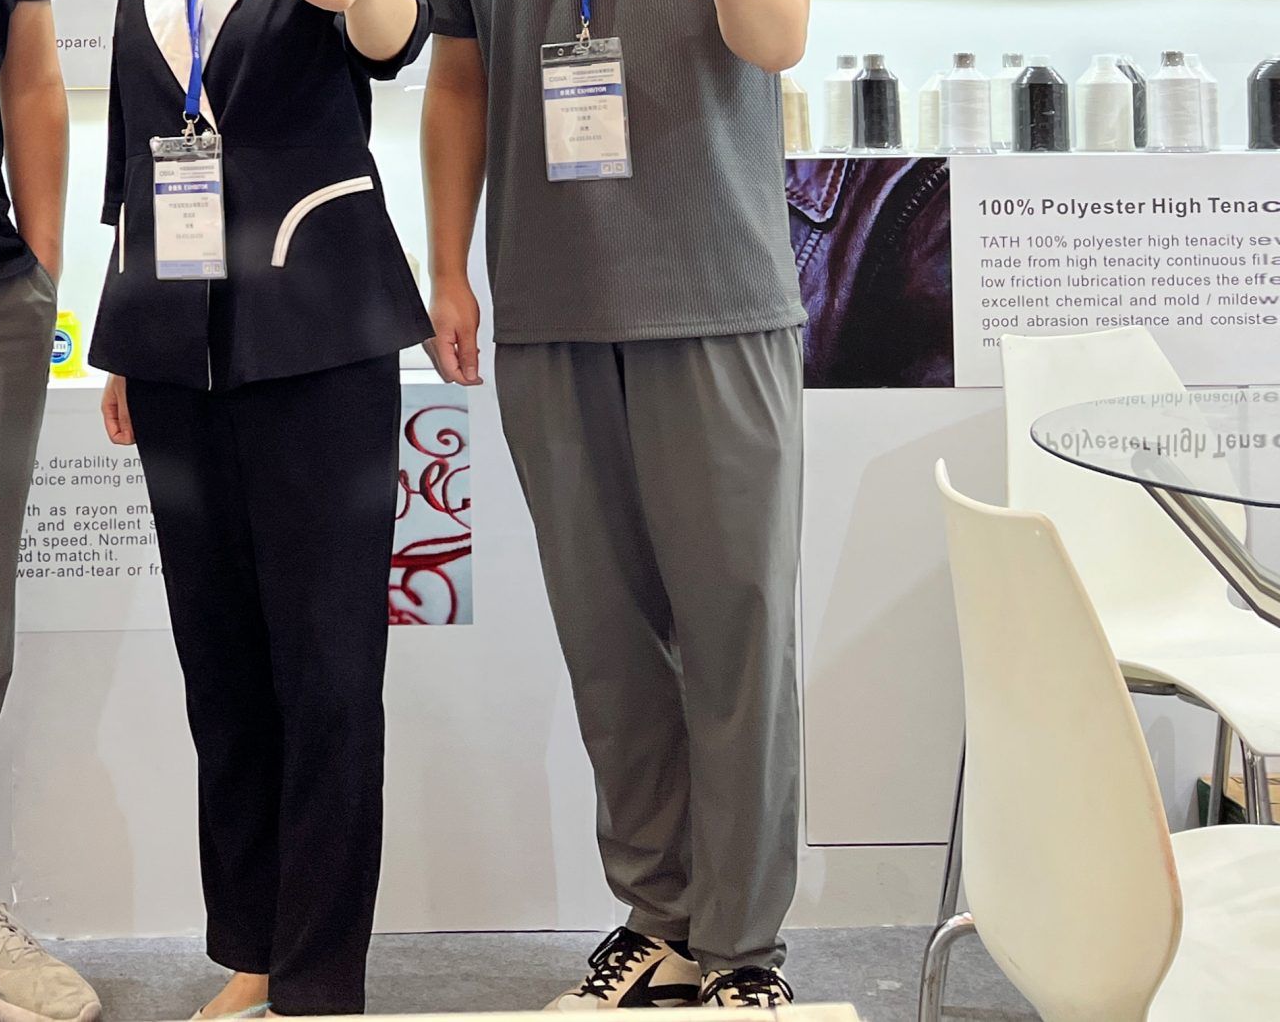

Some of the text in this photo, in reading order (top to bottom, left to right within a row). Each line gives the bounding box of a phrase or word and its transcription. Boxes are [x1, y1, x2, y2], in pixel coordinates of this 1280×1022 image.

[978, 197, 1201, 219] 100% Polyester High
[979, 233, 1244, 251] TATH 100% polyester high tenacity
[980, 253, 1247, 271] made from high tenacity continuous
[980, 272, 1239, 288] low friction lubrication reduces the
[981, 292, 1279, 308] excellent chemical and mold mildew
[981, 314, 1019, 331] good
[1025, 313, 1089, 327] abrasion
[1095, 313, 1170, 326] resistance
[1176, 312, 1203, 326] and
[48, 455, 119, 471] durability
[70, 474, 121, 488] among
[48, 504, 117, 519] as rayon
[36, 517, 141, 532] and excellent
[41, 533, 92, 550] speed.
[36, 548, 118, 563] to match it.
[126, 565, 142, 576] or
